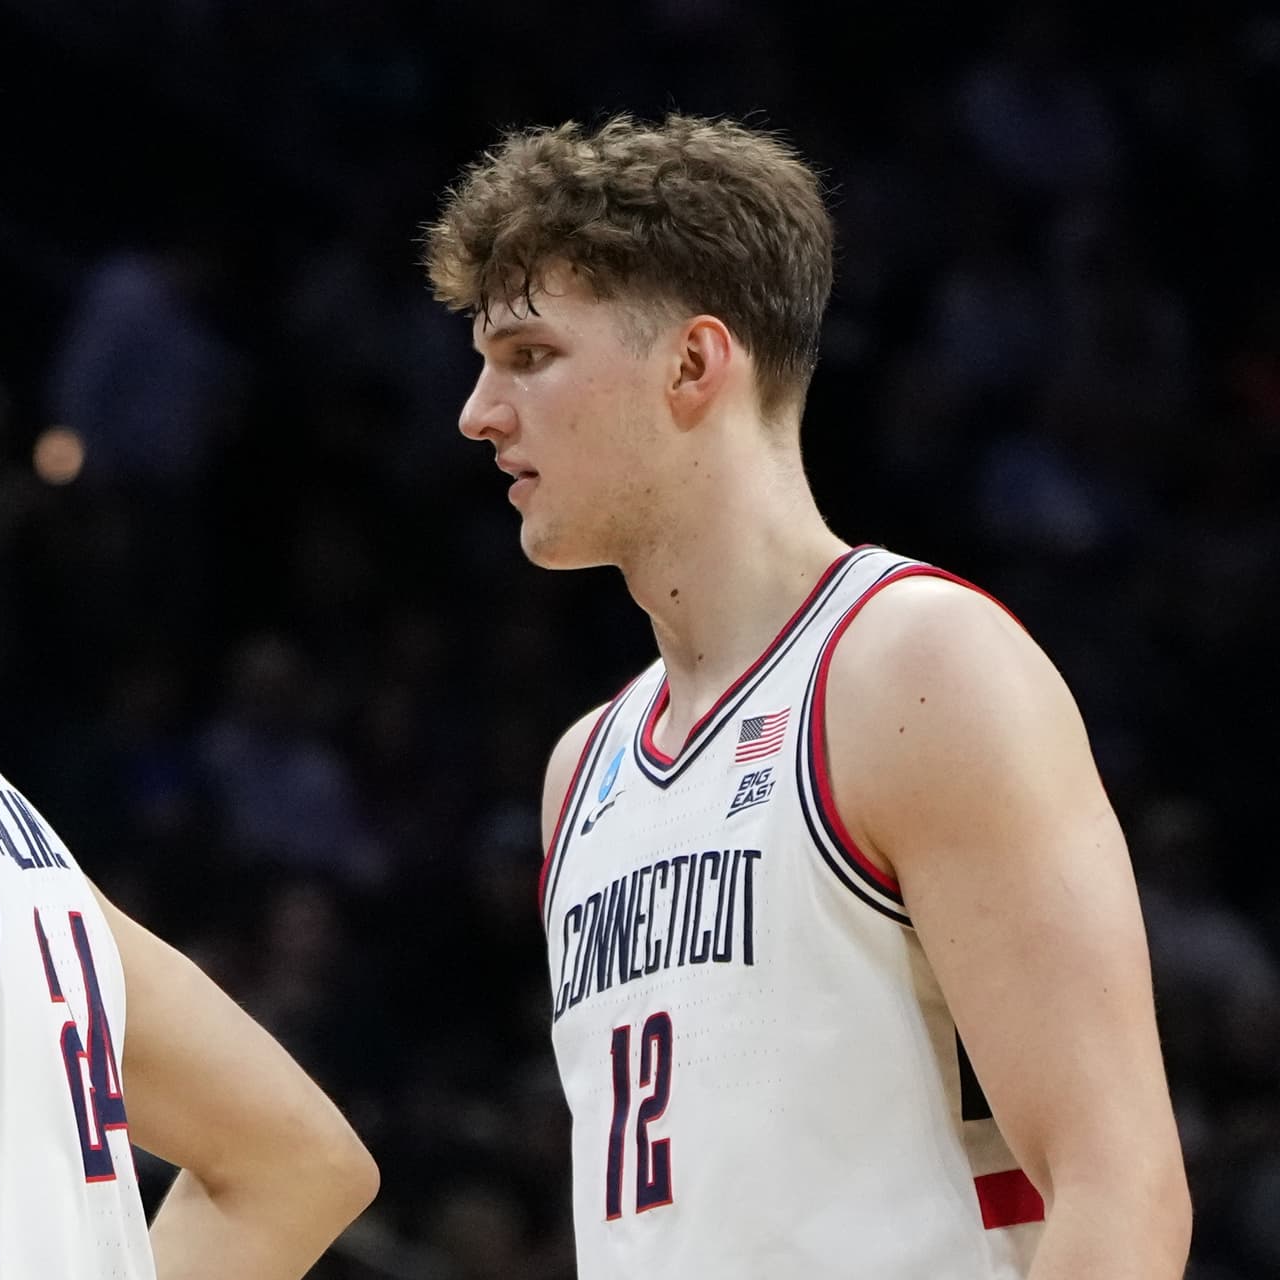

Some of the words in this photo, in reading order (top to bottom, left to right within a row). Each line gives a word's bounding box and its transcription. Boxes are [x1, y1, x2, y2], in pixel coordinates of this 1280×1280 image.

[730, 780, 776, 808] EAST
[738, 767, 774, 791] BIG
[554, 849, 762, 1024] CONNECTICUT
[605, 1010, 674, 1222] 12
